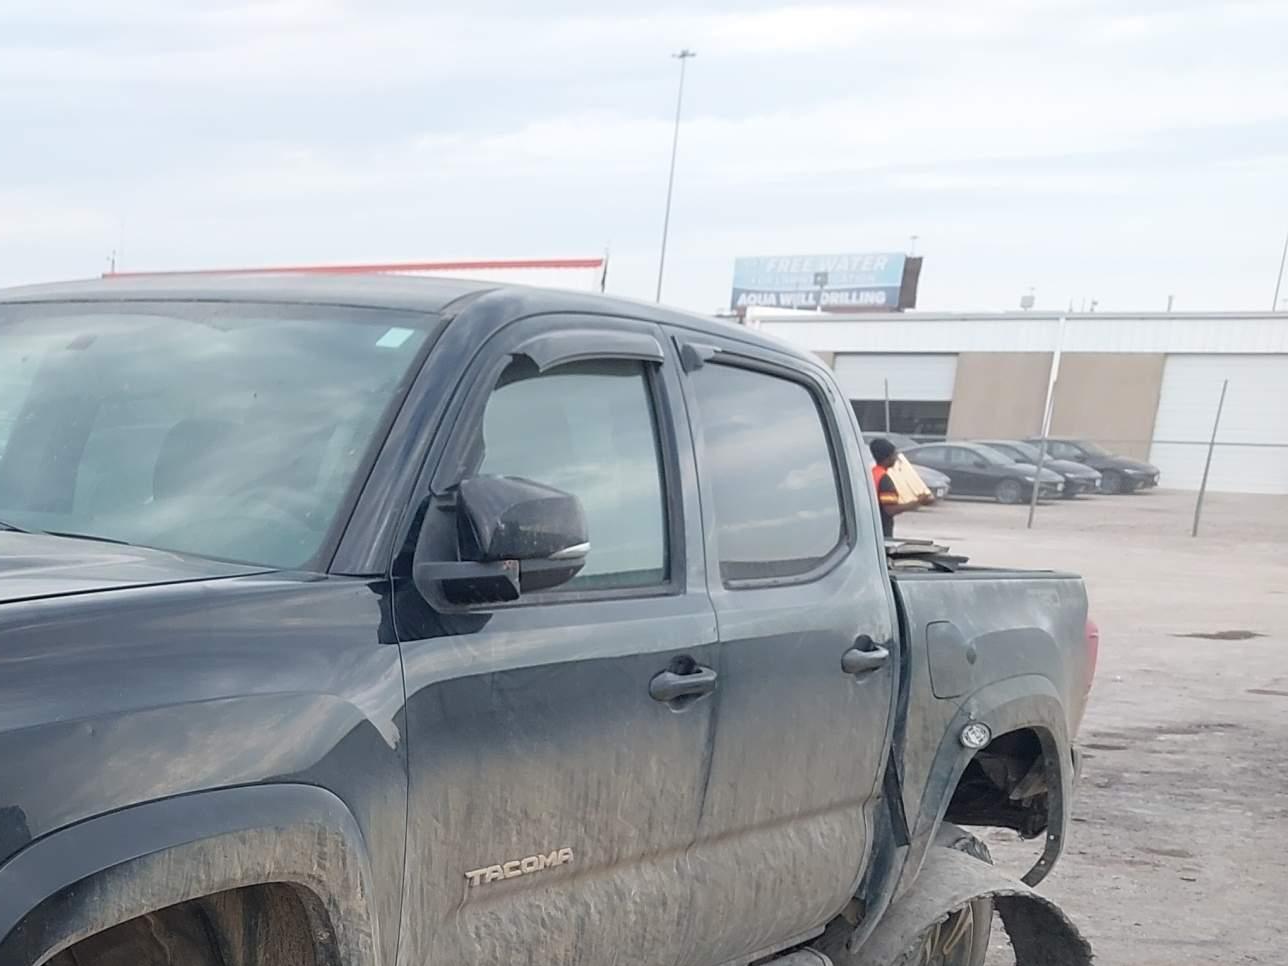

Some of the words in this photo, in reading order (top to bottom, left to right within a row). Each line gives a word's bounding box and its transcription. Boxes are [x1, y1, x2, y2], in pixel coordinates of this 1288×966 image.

[765, 256, 814, 272] FREE
[737, 292, 777, 306] AQUA
[821, 290, 886, 305] DRILLING
[465, 847, 574, 886] TACOMA
